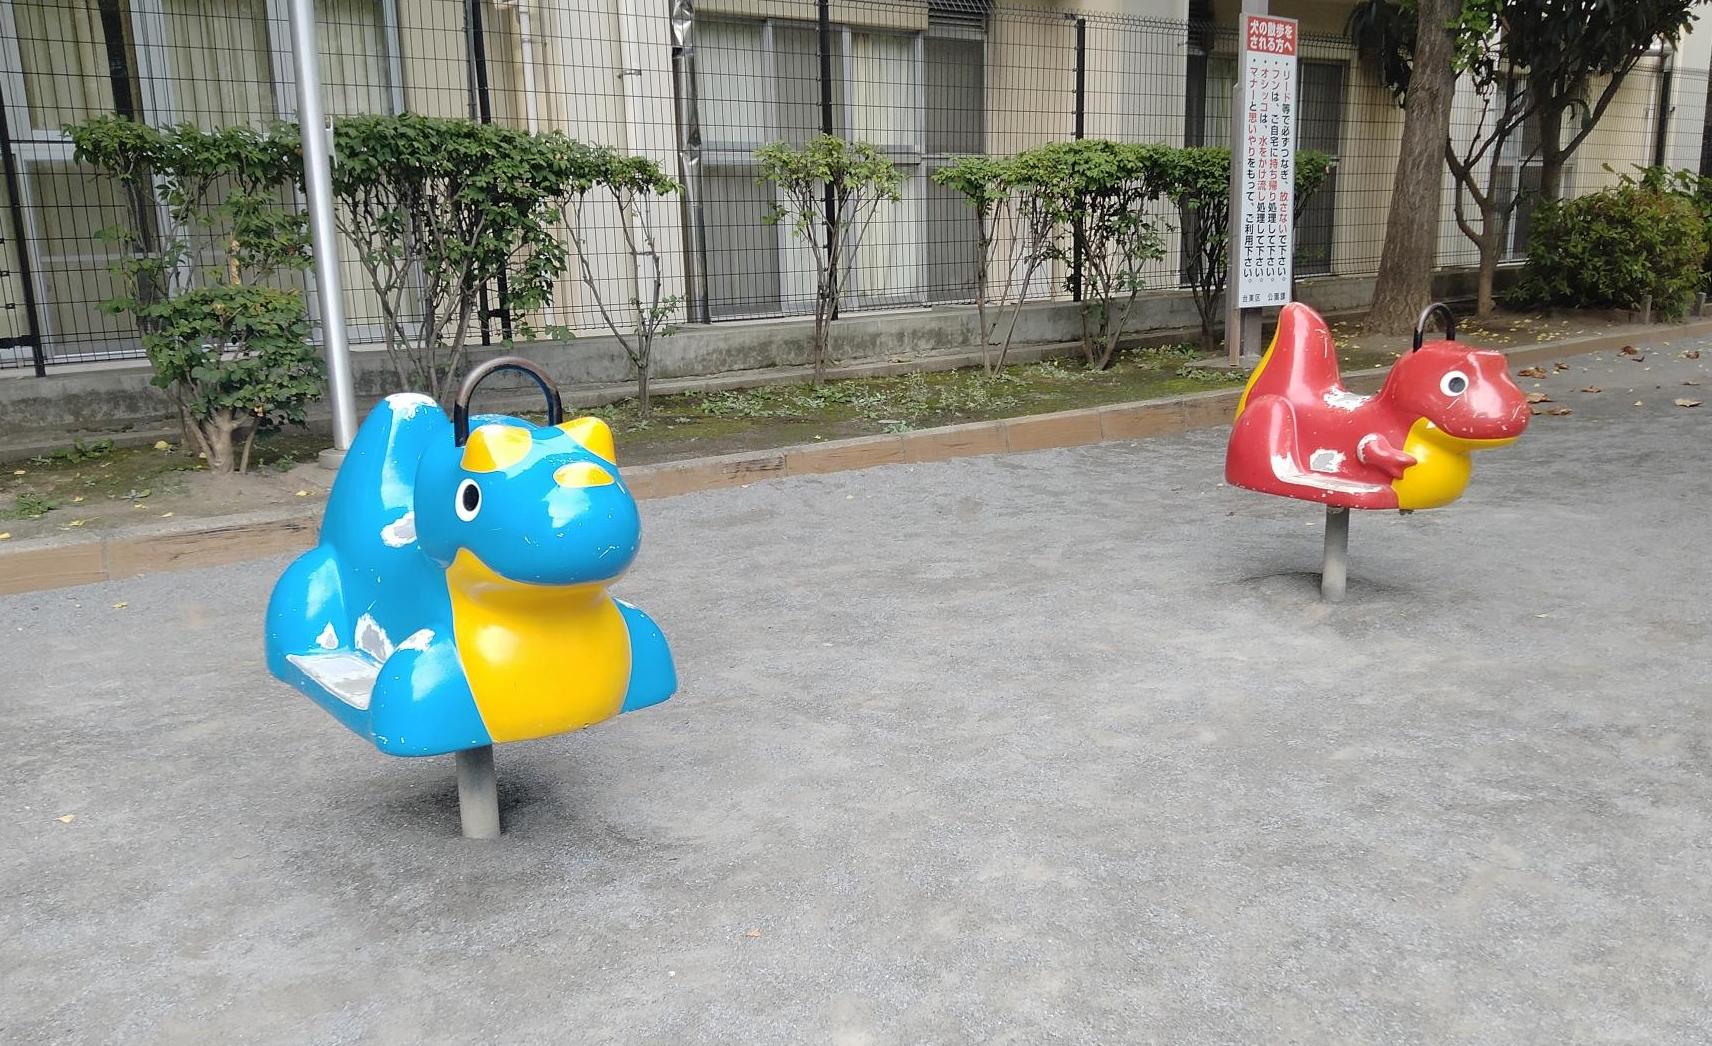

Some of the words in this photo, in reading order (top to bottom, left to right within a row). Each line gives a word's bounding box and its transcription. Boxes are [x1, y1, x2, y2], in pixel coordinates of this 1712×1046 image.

[1250, 19, 1293, 39] 犬の散歩を
[1250, 35, 1293, 53] される方へ
